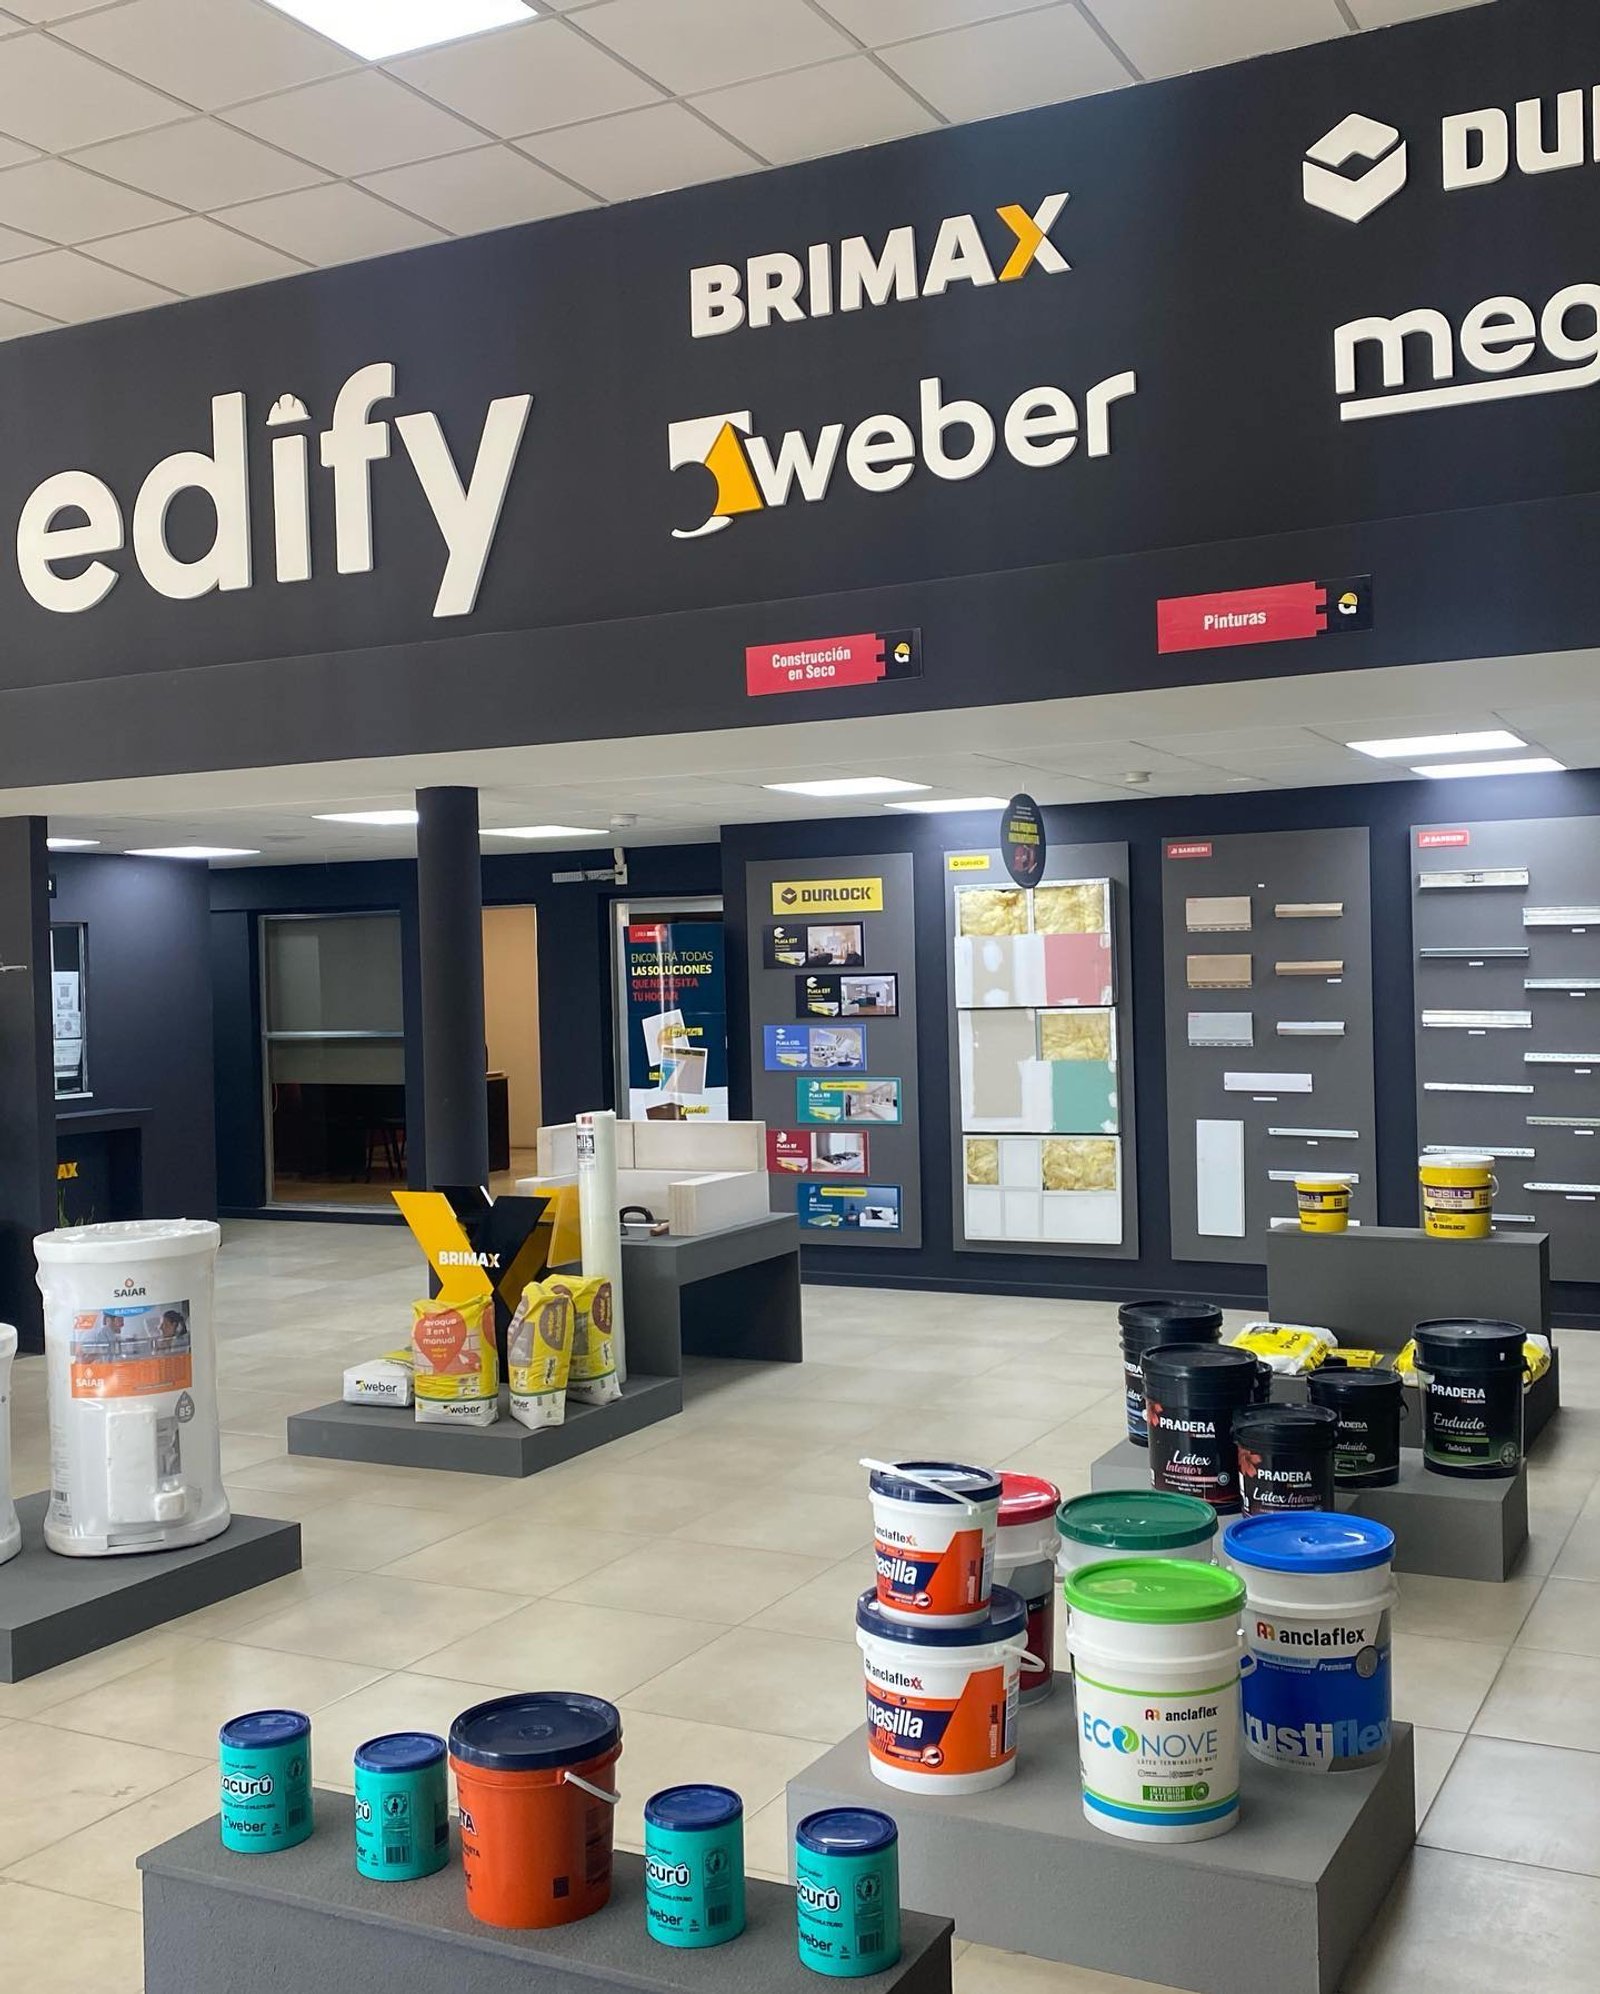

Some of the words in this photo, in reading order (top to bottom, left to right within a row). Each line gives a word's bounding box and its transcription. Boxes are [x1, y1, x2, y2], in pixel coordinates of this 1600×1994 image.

[1442, 85, 1600, 191] DU
[689, 192, 1072, 339] BRIMAX
[744, 370, 1136, 508] weber
[16, 362, 533, 618] edify
[1203, 609, 1267, 631] Pinturas
[771, 646, 852, 668] Construcción
[788, 666, 804, 680] en
[805, 663, 836, 679] Seco
[801, 887, 871, 902] DURLOCK
[680, 951, 714, 962] TODAS
[631, 966, 647, 976] LAS
[647, 964, 713, 975] SOLUCIONES
[632, 978, 650, 989] QUE
[650, 977, 699, 988] NECESITA
[438, 1250, 500, 1268] BRIMAX
[113, 1287, 146, 1298] SAIAR
[422, 1336, 456, 1346] manual
[76, 1378, 105, 1388] SAIAR
[363, 1381, 398, 1393] weber
[1431, 1383, 1486, 1399] PRADERA
[450, 1404, 481, 1415] weber
[1159, 1416, 1216, 1433] PRADERA
[1432, 1411, 1485, 1430] Enduido
[1257, 1468, 1313, 1482] PRADERA
[1279, 1627, 1365, 1646] anclaflex
[868, 1699, 924, 1739] masilla
[1165, 1706, 1218, 1721] anclaflex
[229, 1820, 267, 1833] weber
